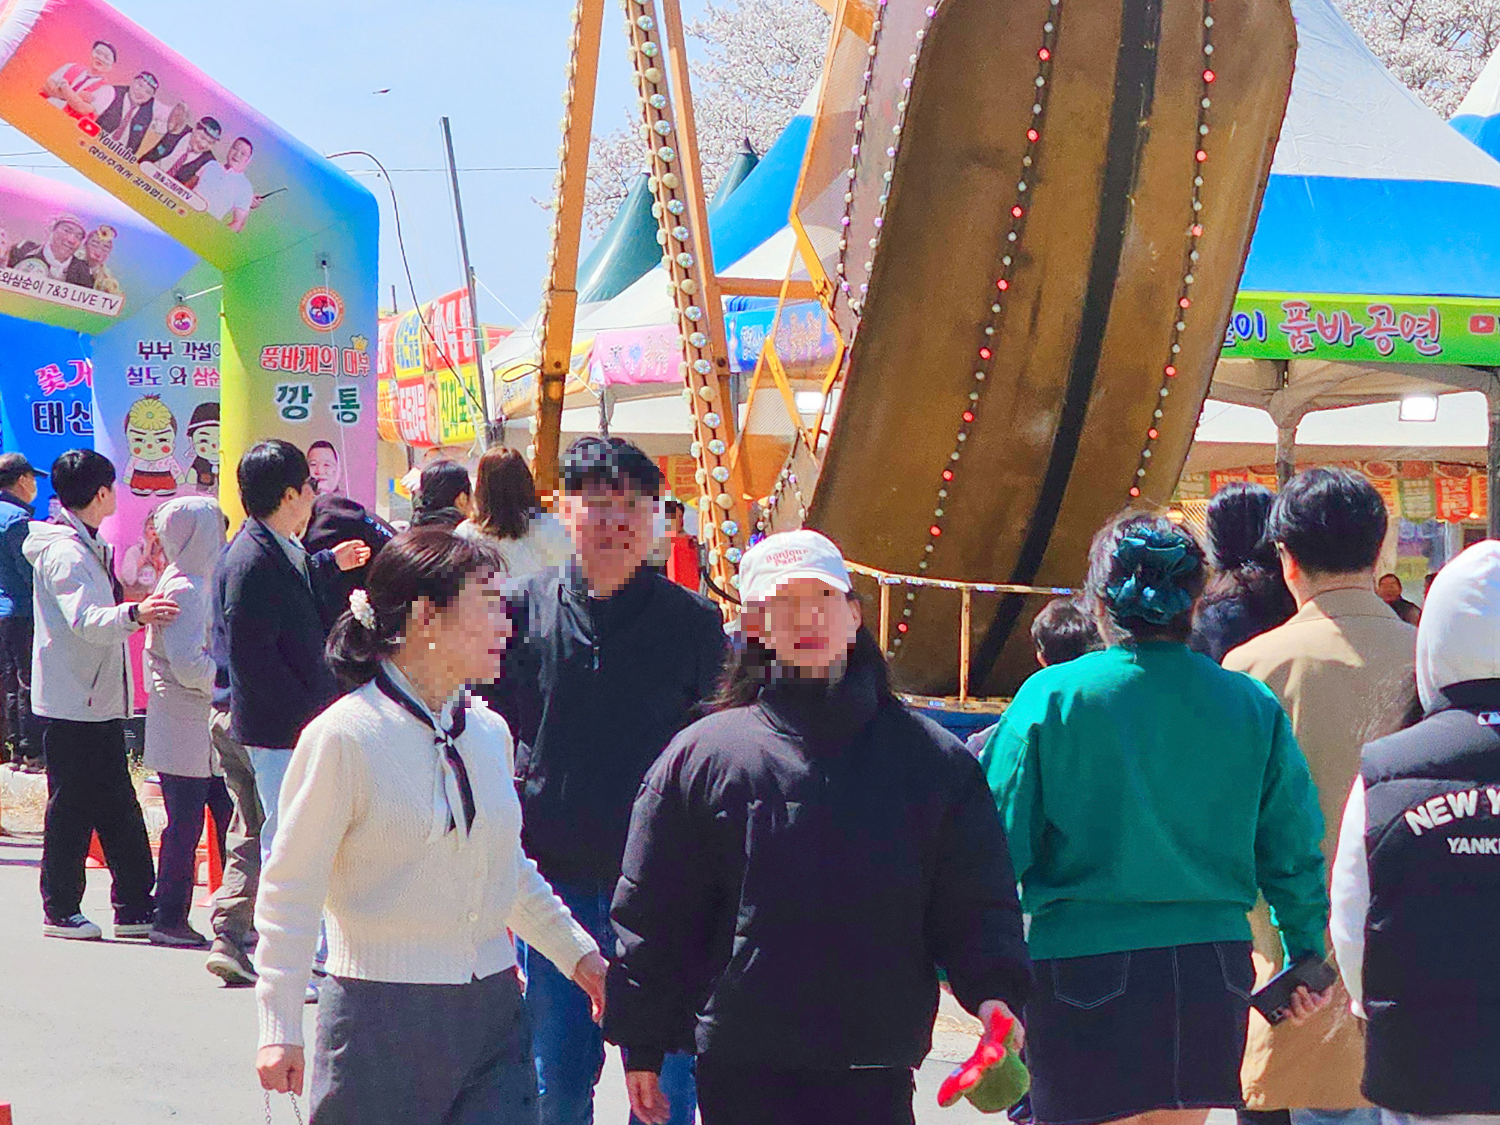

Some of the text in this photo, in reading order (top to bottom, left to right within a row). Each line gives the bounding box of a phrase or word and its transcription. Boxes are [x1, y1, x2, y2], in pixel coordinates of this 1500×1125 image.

[98, 131, 138, 165] YouTube
[0, 270, 119, 311] 와삼순이 7&3 LIVE TV
[1279, 300, 1443, 356] 품바공연
[137, 341, 174, 362] 부부
[261, 345, 339, 375] 품바계의
[127, 365, 163, 387] 칠도
[169, 365, 188, 387] 와
[1404, 789, 1479, 836] NEW
